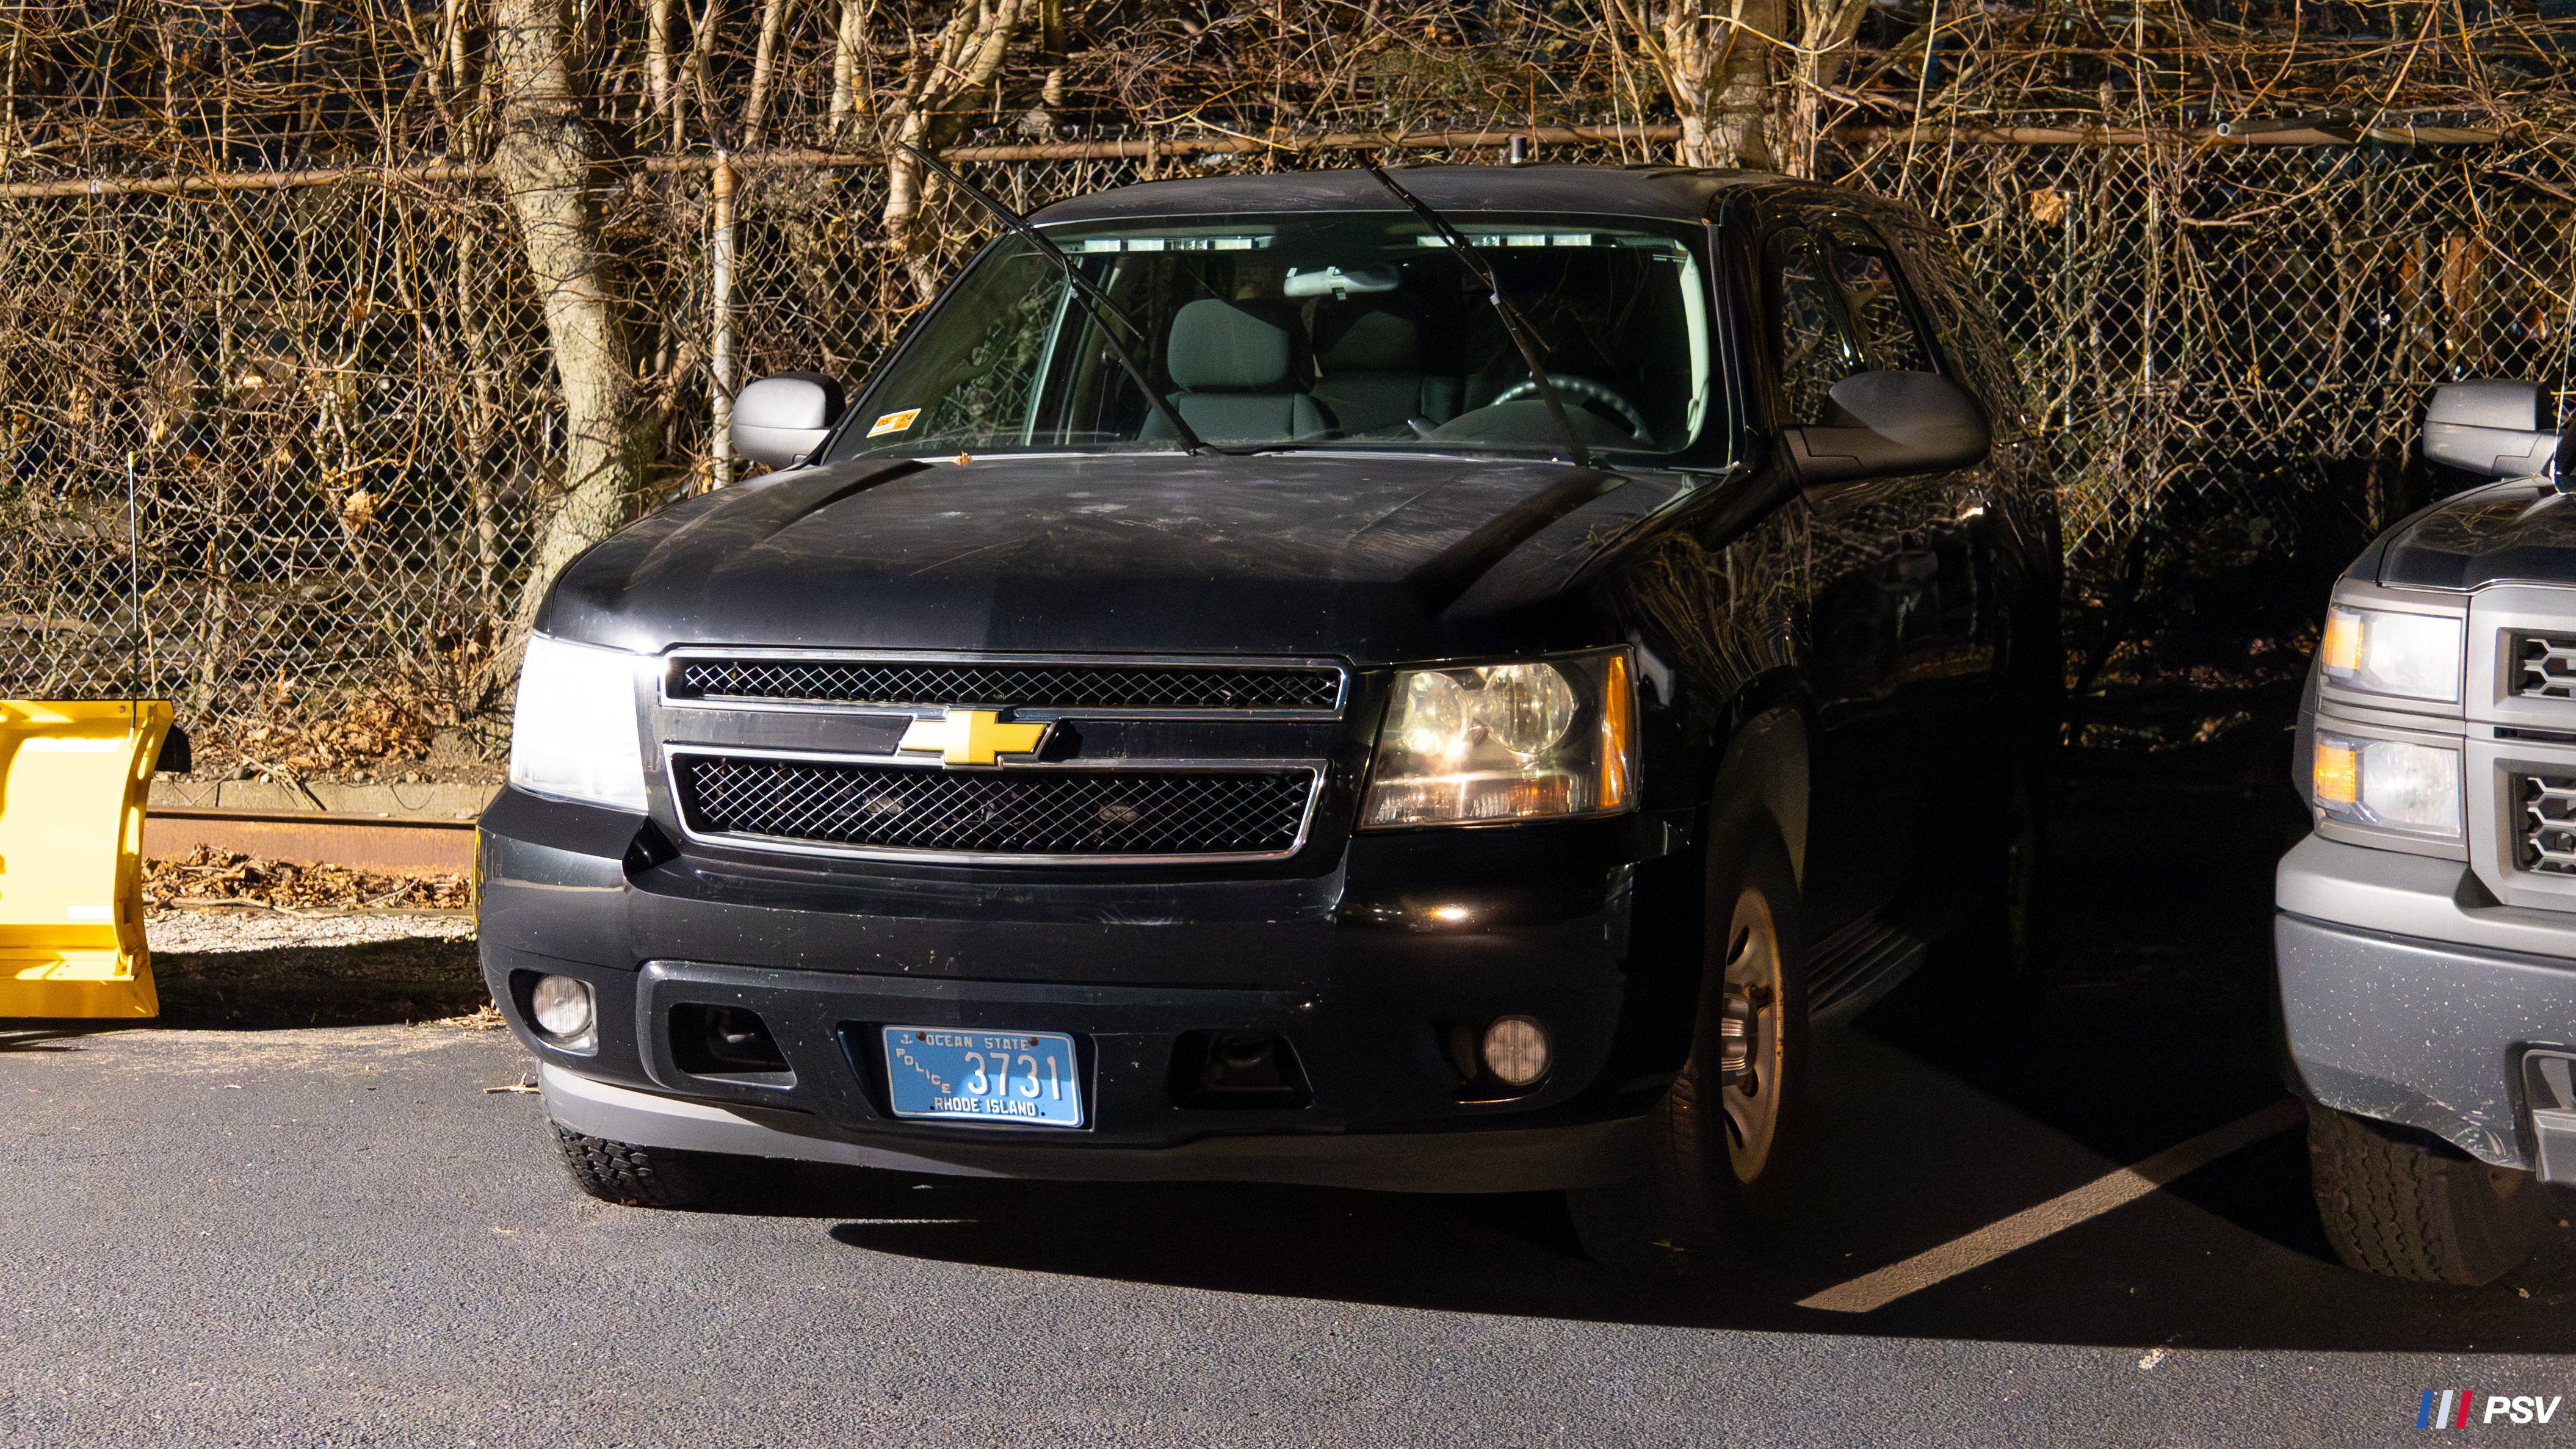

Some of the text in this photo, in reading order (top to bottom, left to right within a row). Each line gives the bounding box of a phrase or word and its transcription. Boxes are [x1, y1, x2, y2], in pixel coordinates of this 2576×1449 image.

[926, 1035, 1029, 1051] OCEAN STATE
[896, 1048, 951, 1094] POLICE
[964, 1051, 1060, 1100] 3731
[934, 1097, 1037, 1117] RHODE ISLAND
